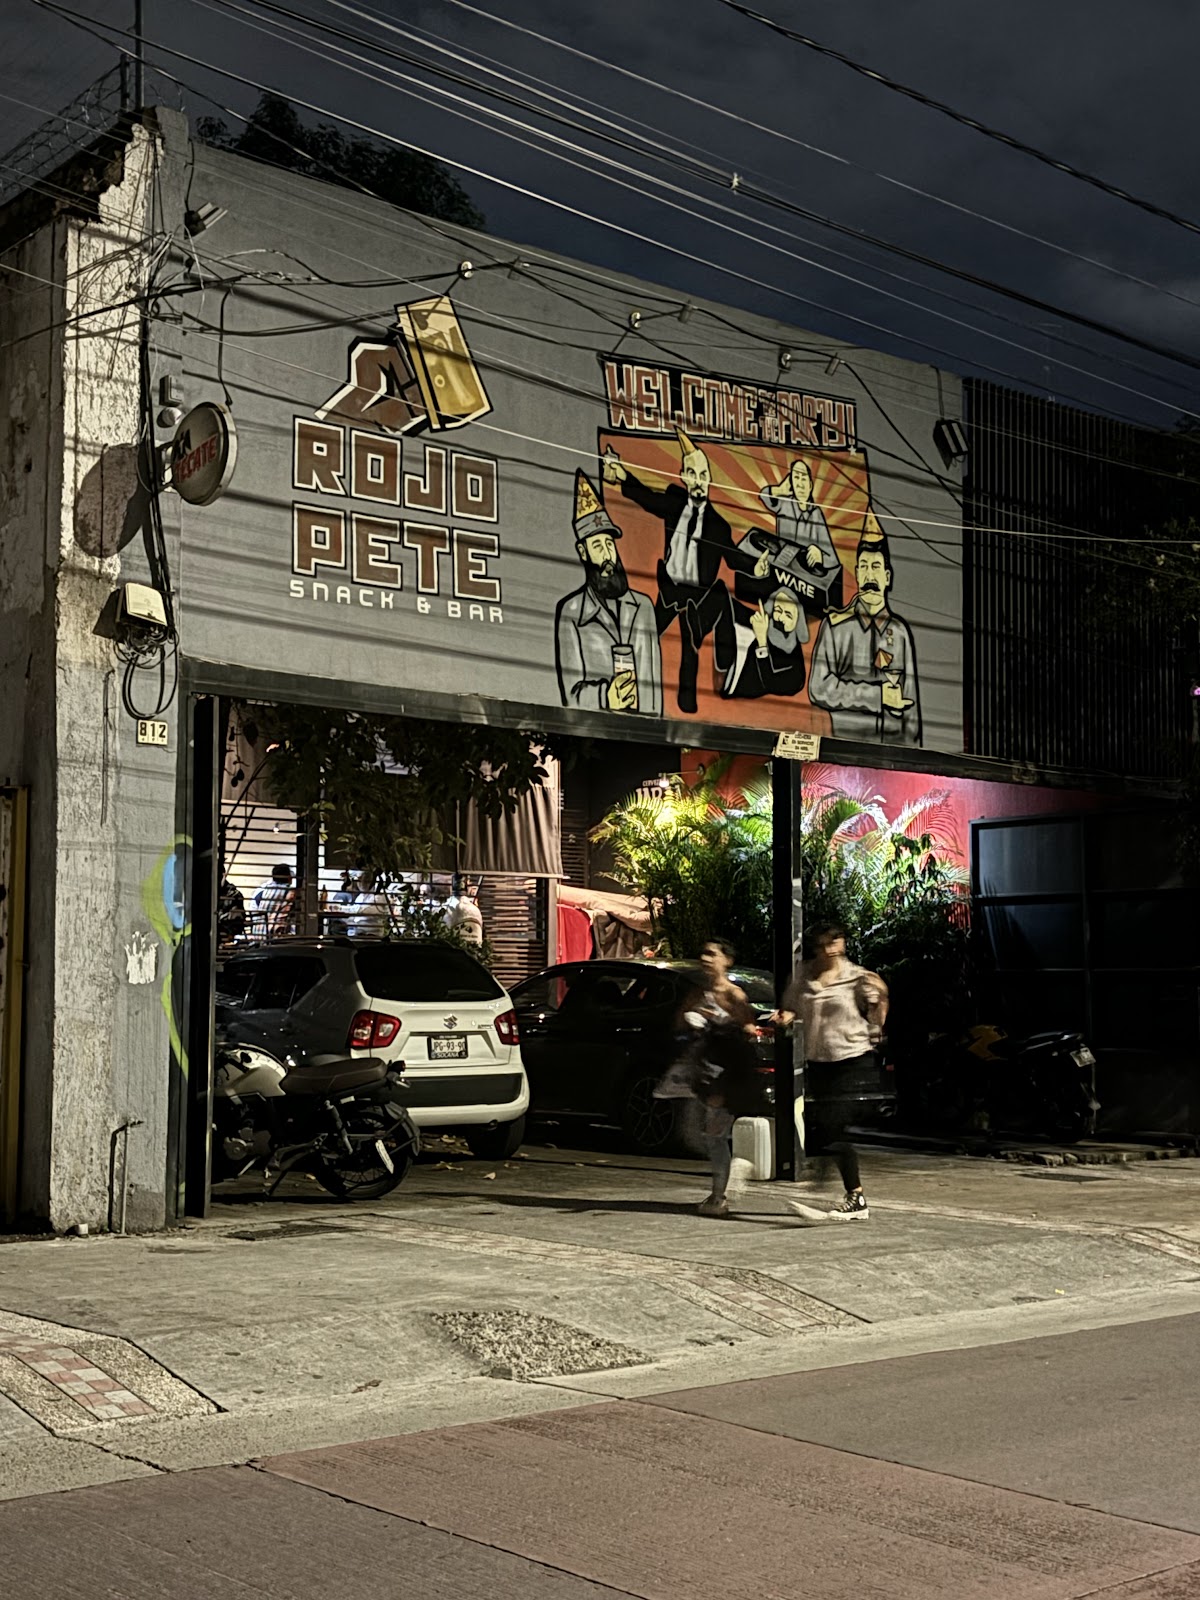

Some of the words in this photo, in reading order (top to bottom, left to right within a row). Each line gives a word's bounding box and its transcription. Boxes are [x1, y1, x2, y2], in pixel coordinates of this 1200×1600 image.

[606, 362, 758, 439] WELCOME
[174, 435, 217, 484] TECATE
[293, 415, 499, 523] ROJO
[292, 500, 502, 603] PETE
[289, 579, 395, 610] SNACK
[416, 597, 431, 613] &
[447, 602, 504, 624] BAR
[139, 721, 167, 739] 812
